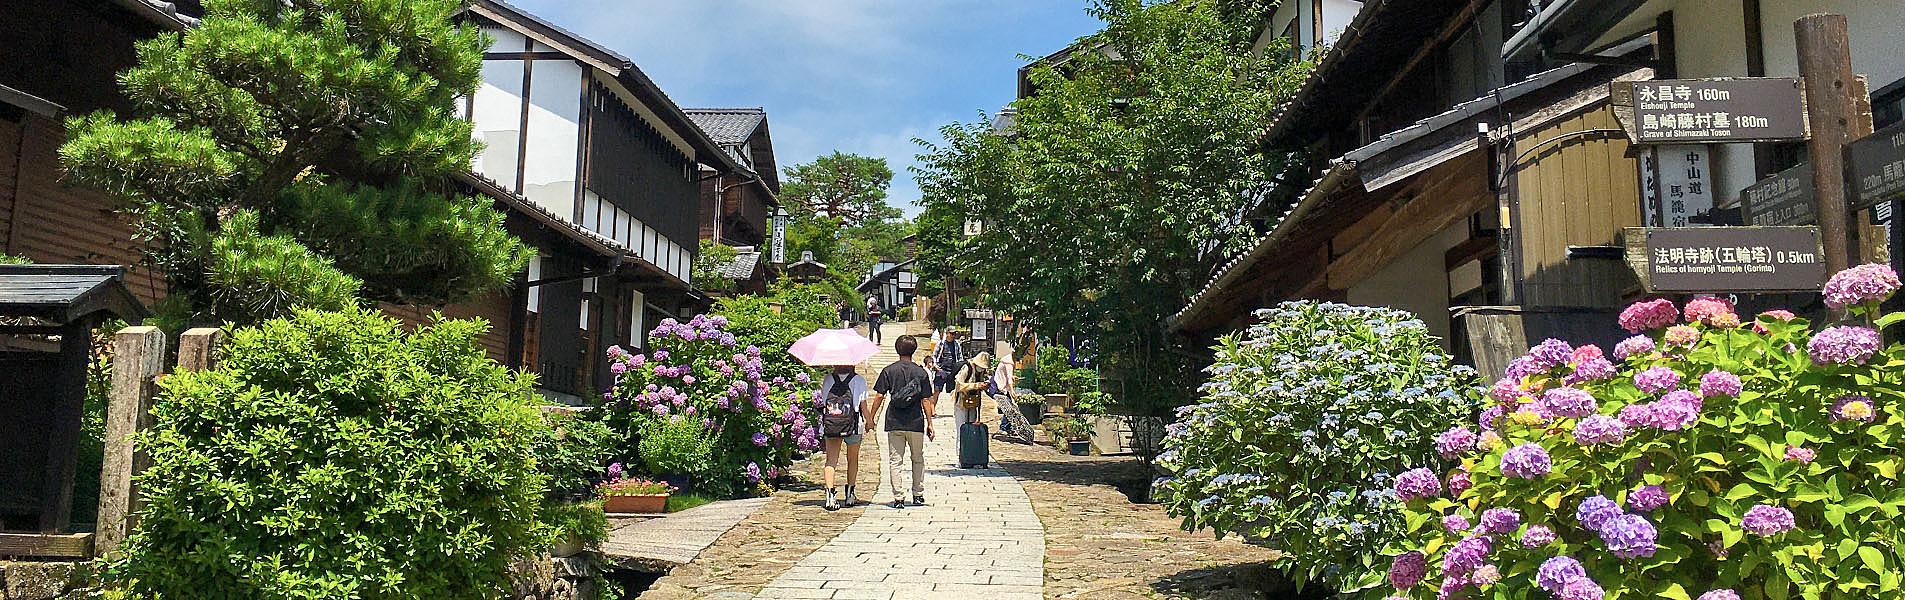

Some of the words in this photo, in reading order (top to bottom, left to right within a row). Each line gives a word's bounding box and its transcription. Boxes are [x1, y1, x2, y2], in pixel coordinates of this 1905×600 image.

[1640, 85, 1692, 101] 永昌寺
[1697, 88, 1730, 101] 160m
[1670, 102, 1695, 110] Temple
[1642, 112, 1730, 130] 島崎藤村墓
[1734, 115, 1768, 128] 180m
[1643, 130, 1664, 138] Grave
[1673, 129, 1709, 137] Shimazaki
[1710, 129, 1731, 137] Toson
[1686, 151, 1702, 195] 中山道
[1776, 250, 1815, 263] 0.5km
[1655, 264, 1678, 273] Relics
[1679, 265, 1687, 273] of
[1718, 264, 1743, 274] Temple
[1744, 264, 1776, 274] (Gorinto)
